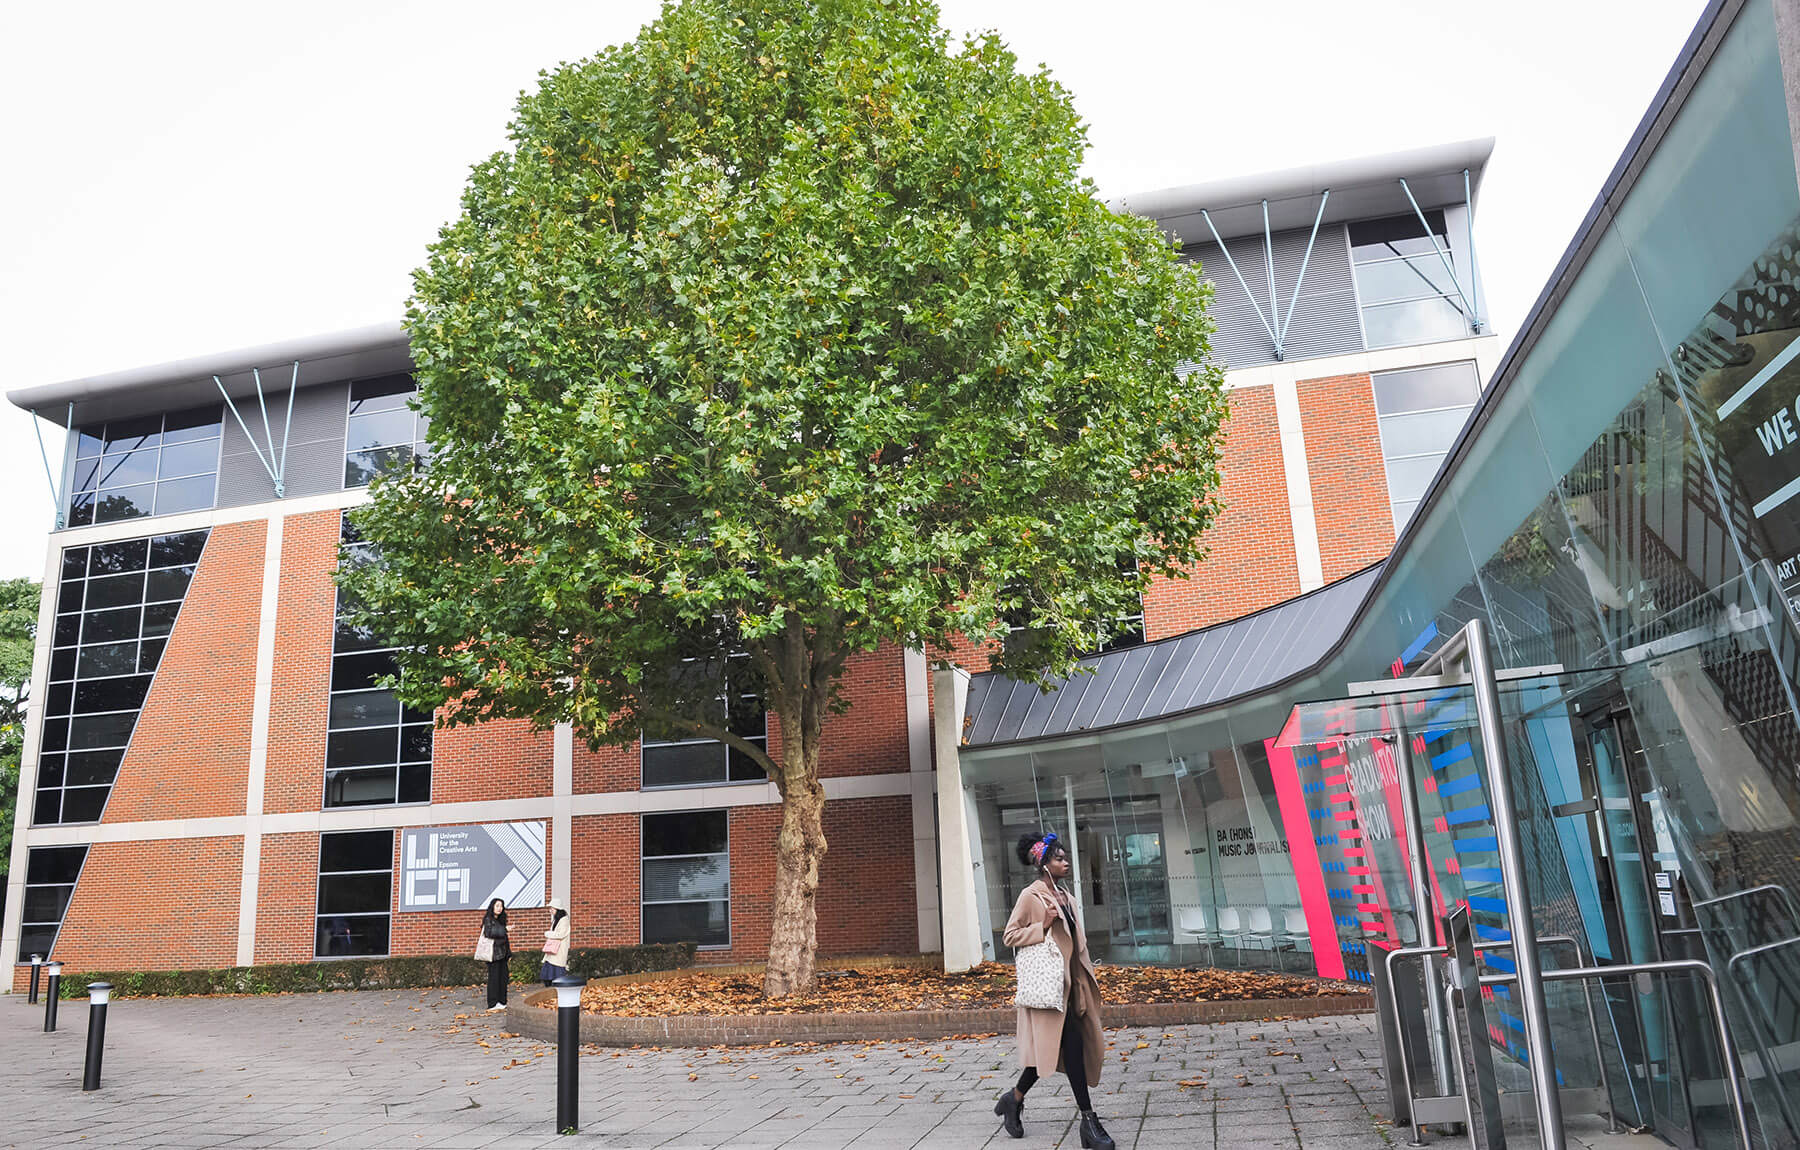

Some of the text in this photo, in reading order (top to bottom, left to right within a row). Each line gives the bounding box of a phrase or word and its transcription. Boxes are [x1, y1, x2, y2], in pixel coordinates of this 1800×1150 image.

[1755, 407, 1798, 457] WE
[1777, 557, 1797, 582] ART
[1356, 803, 1391, 841] SHOW
[1217, 829, 1227, 842] BA
[439, 846, 464, 854] Creative
[1218, 843, 1242, 857] MUSIC
